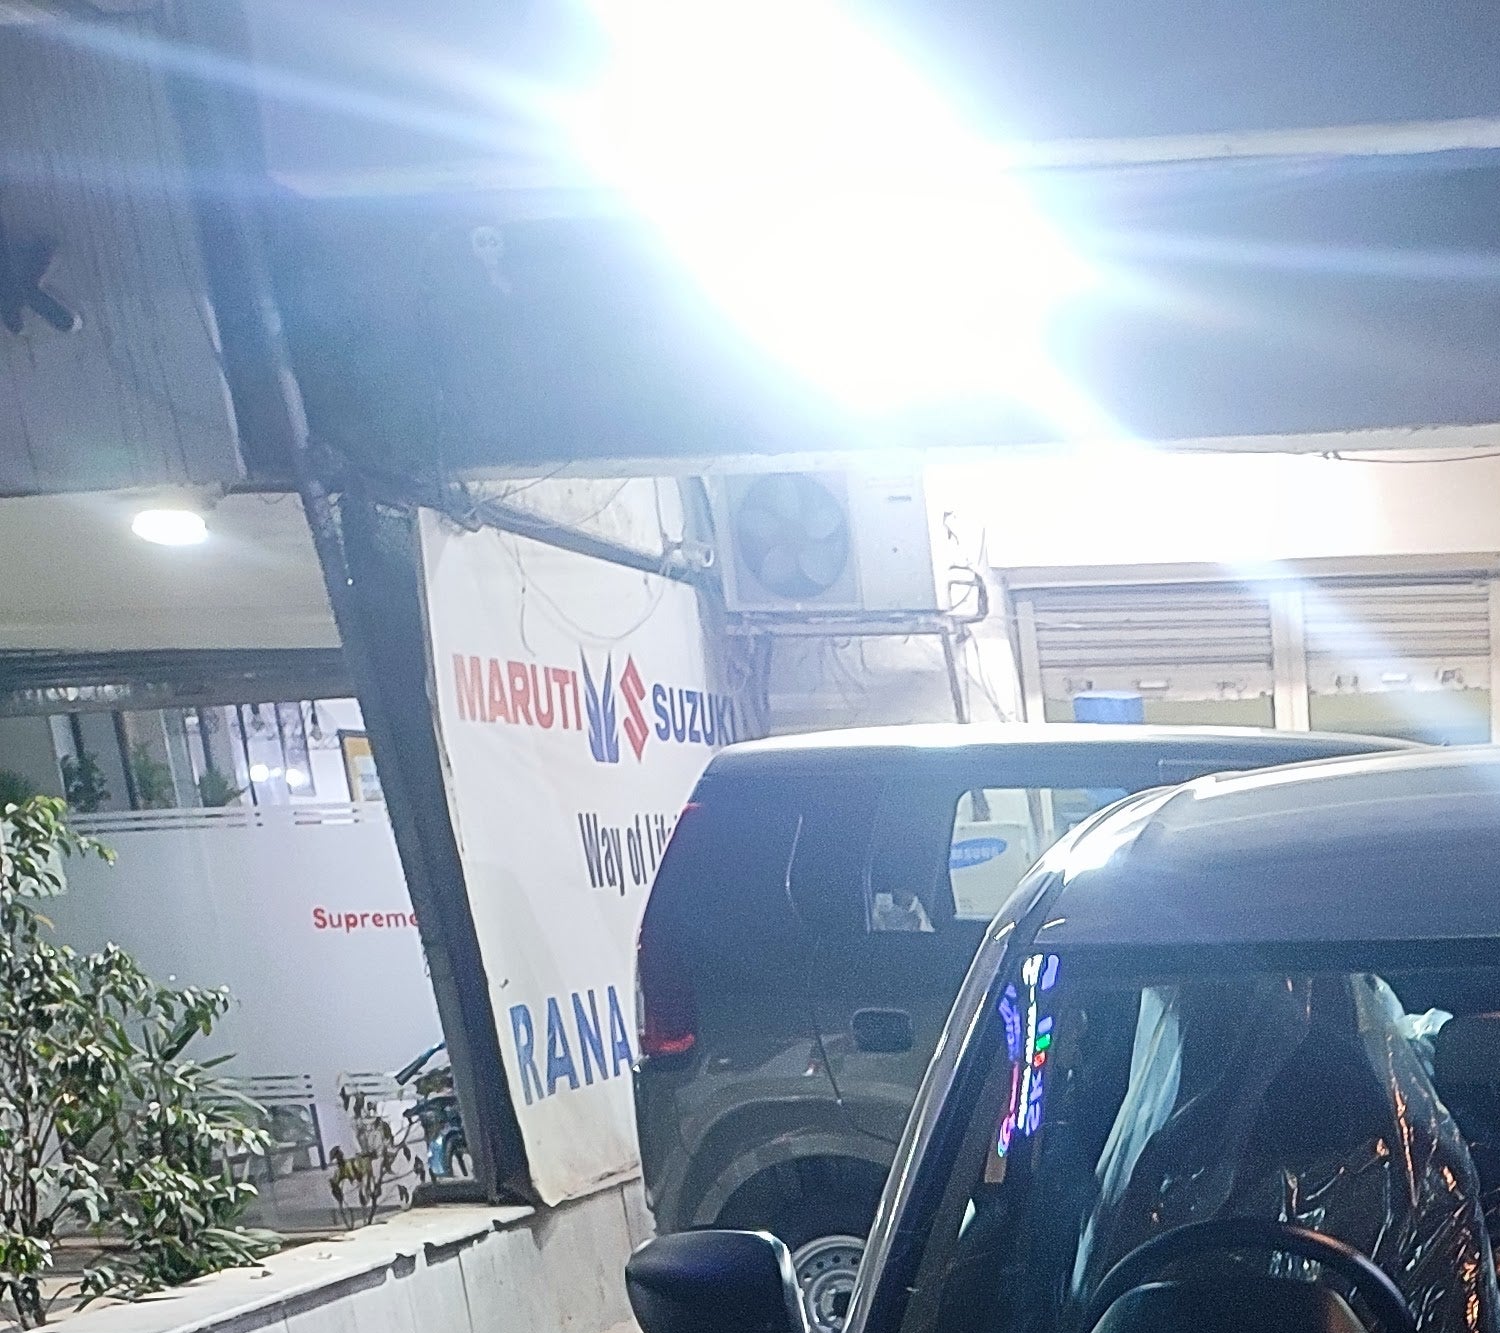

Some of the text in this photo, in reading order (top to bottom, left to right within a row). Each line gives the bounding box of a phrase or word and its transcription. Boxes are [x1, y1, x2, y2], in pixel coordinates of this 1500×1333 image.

[452, 653, 736, 746] MARUTI SUZUKI
[578, 813, 625, 897] Way
[627, 814, 647, 886] of
[509, 985, 634, 1106] RANA
